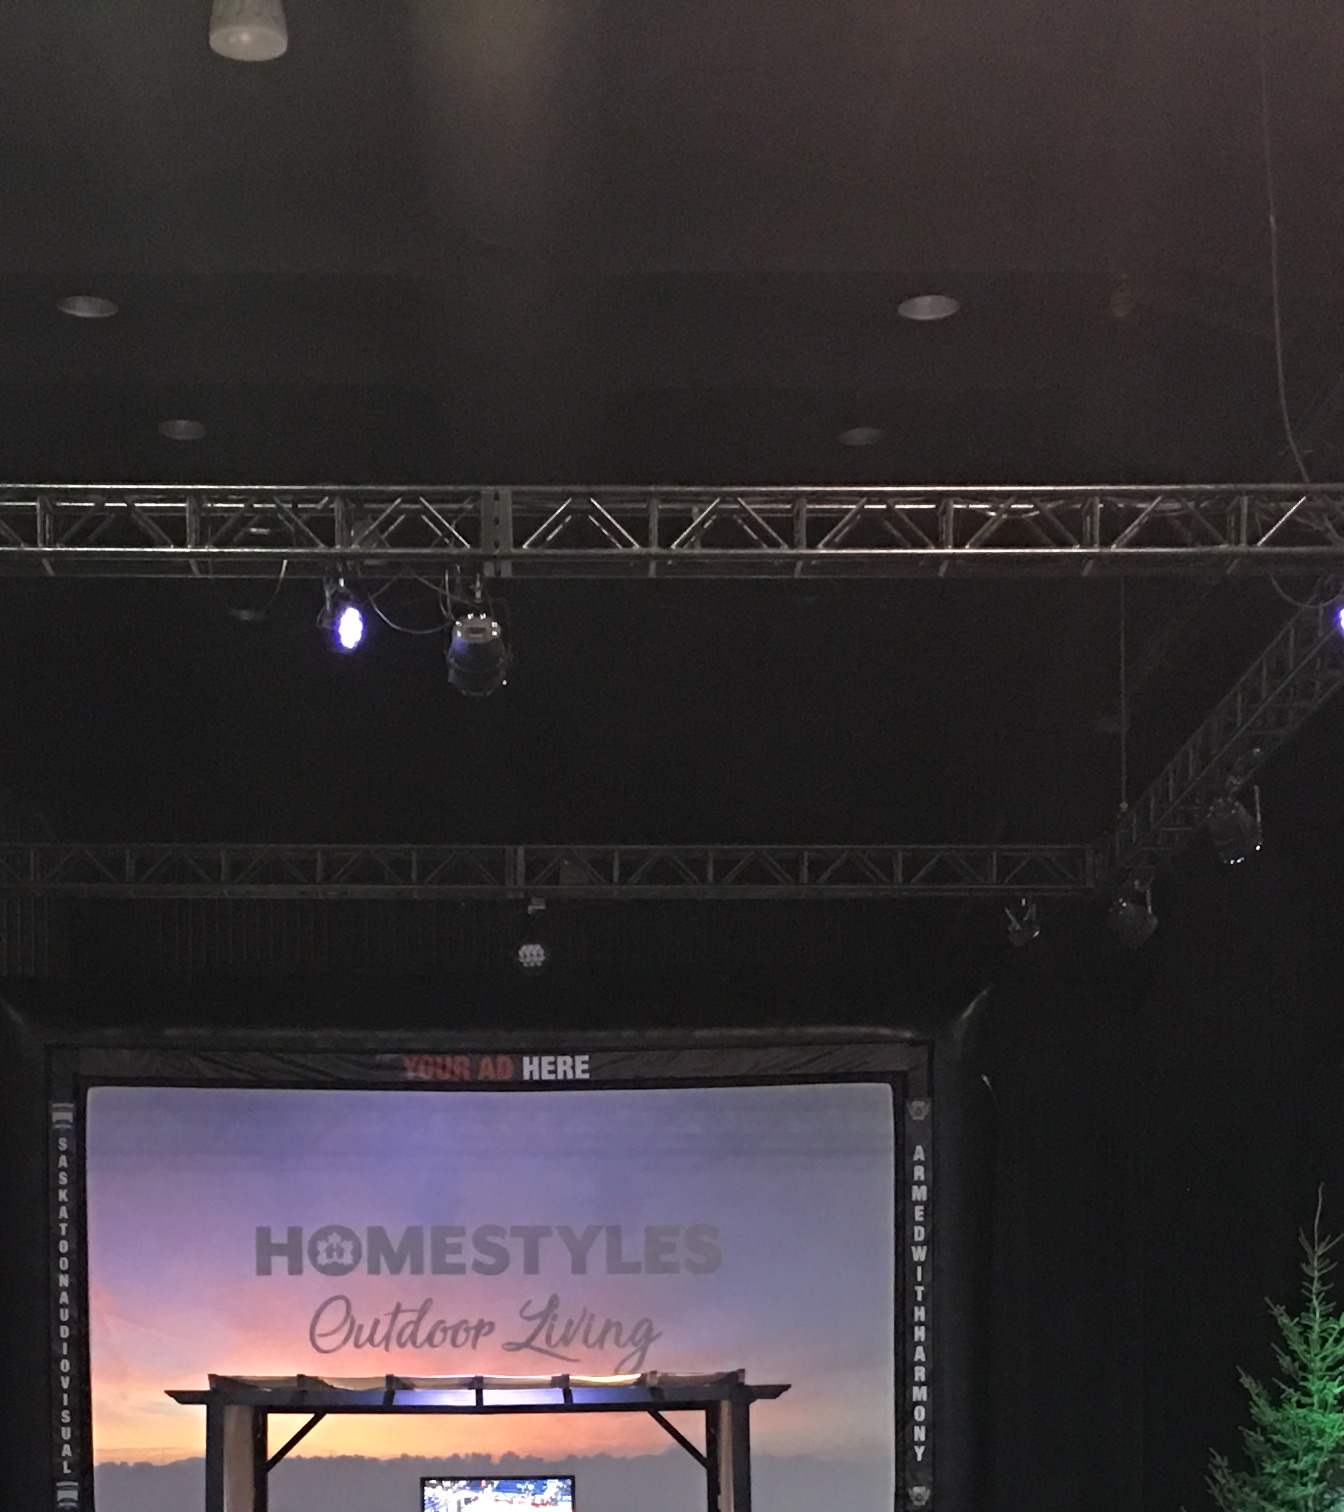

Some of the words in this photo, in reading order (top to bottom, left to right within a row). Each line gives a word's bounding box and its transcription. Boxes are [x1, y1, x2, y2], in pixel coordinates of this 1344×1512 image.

[402, 1055, 471, 1081] YOUR
[477, 1055, 514, 1080] AD
[522, 1055, 590, 1080] HERE
[256, 1224, 723, 1276] HOMESTYLES
[309, 1295, 496, 1354] Outdoor
[502, 1293, 663, 1374] Living
